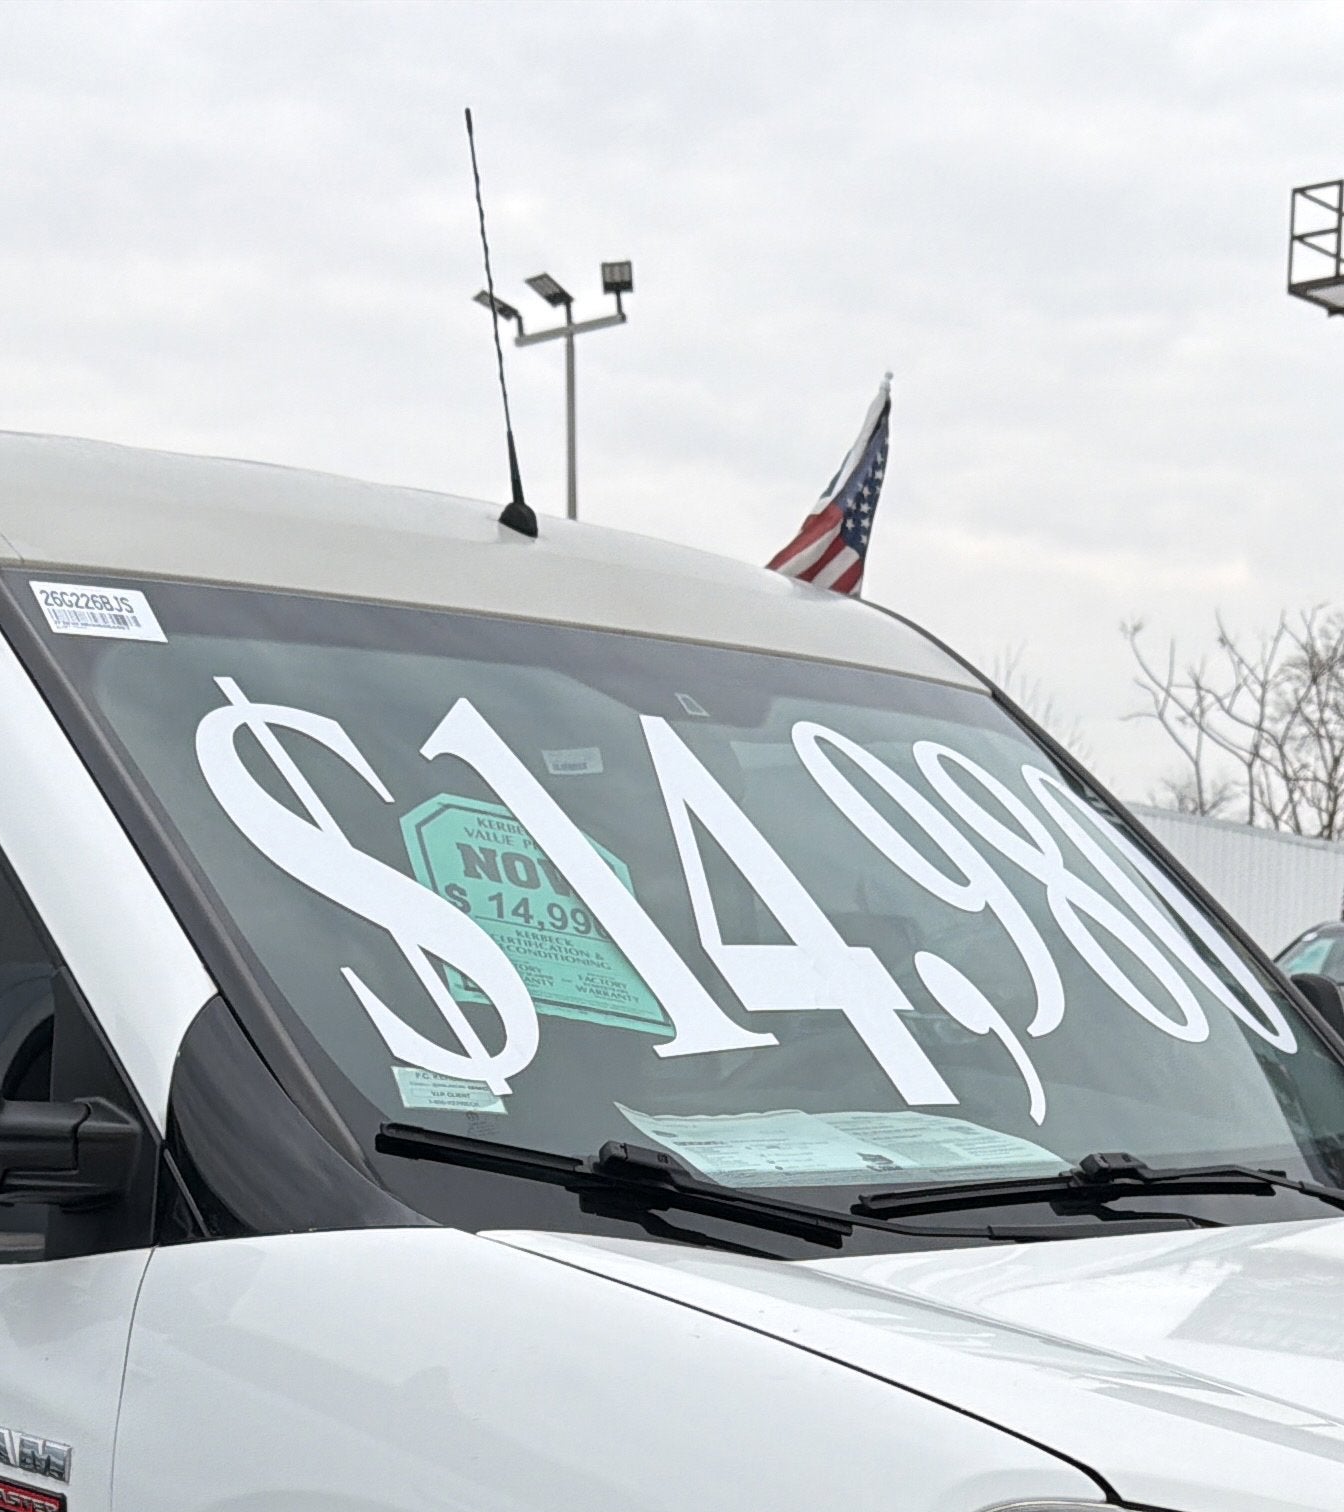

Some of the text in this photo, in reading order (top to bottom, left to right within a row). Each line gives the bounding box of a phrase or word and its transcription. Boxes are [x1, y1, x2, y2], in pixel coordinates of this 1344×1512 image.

[463, 826, 515, 846] VALUE
[476, 816, 526, 836] KERBE
[194, 675, 1299, 1126] $14,980
[487, 891, 610, 939] 14,99
[515, 929, 575, 947] KERBECK
